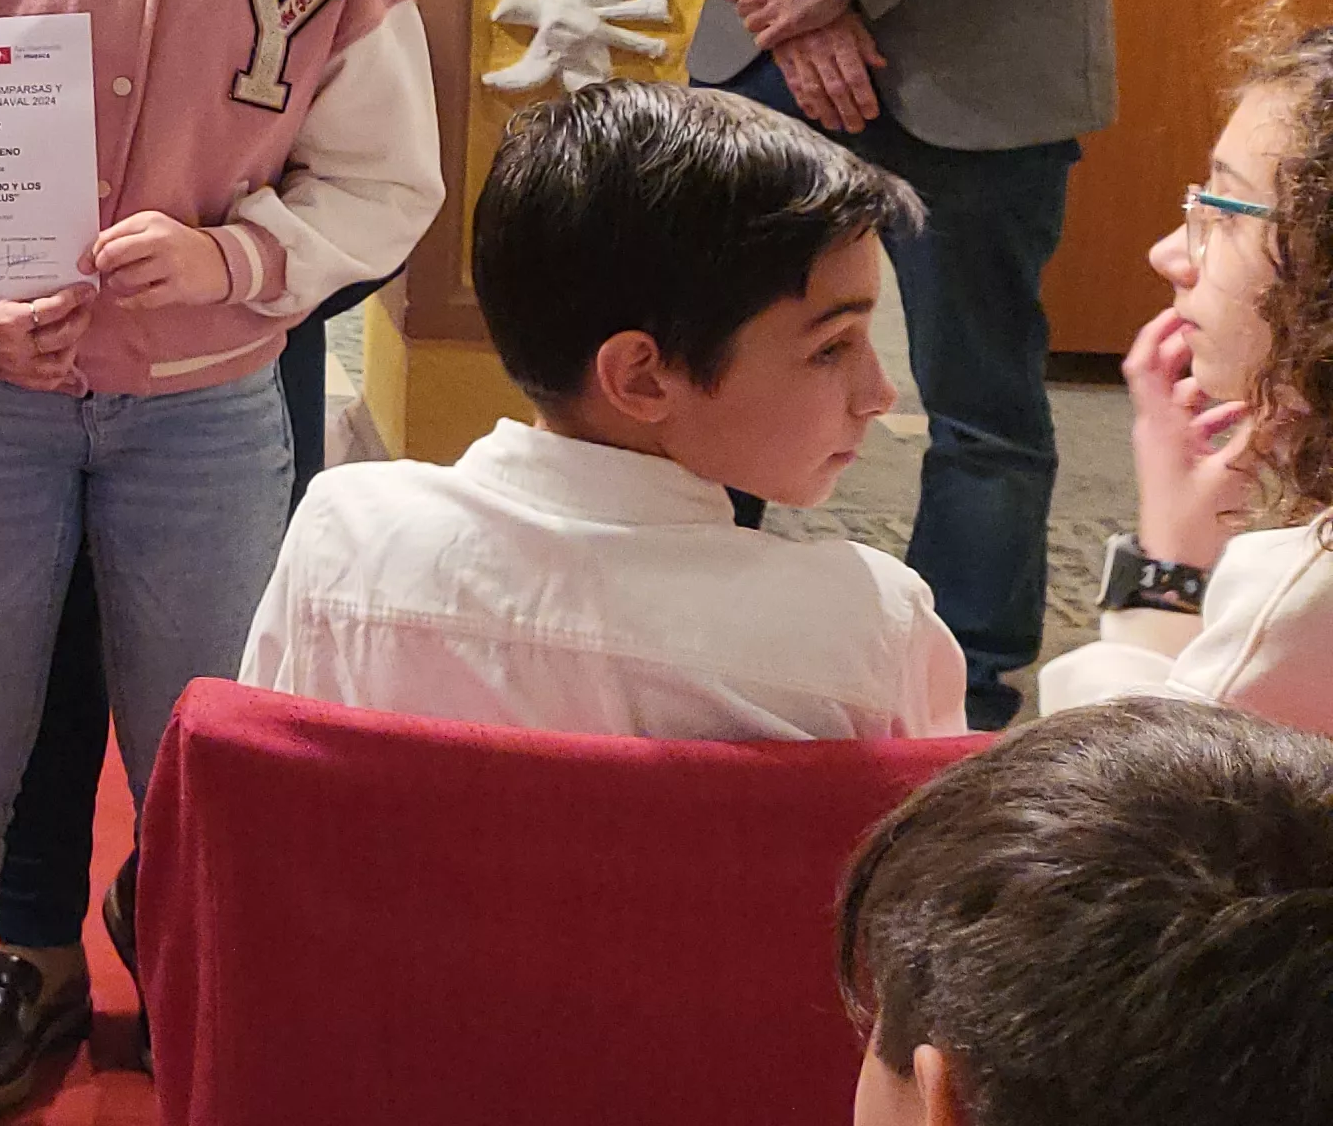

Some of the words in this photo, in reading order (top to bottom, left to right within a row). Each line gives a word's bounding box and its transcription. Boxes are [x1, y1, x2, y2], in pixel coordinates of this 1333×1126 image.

[55, 84, 63, 93] Y
[32, 96, 57, 106] 2024
[11, 182, 19, 191] Y
[21, 181, 42, 191] LOS
